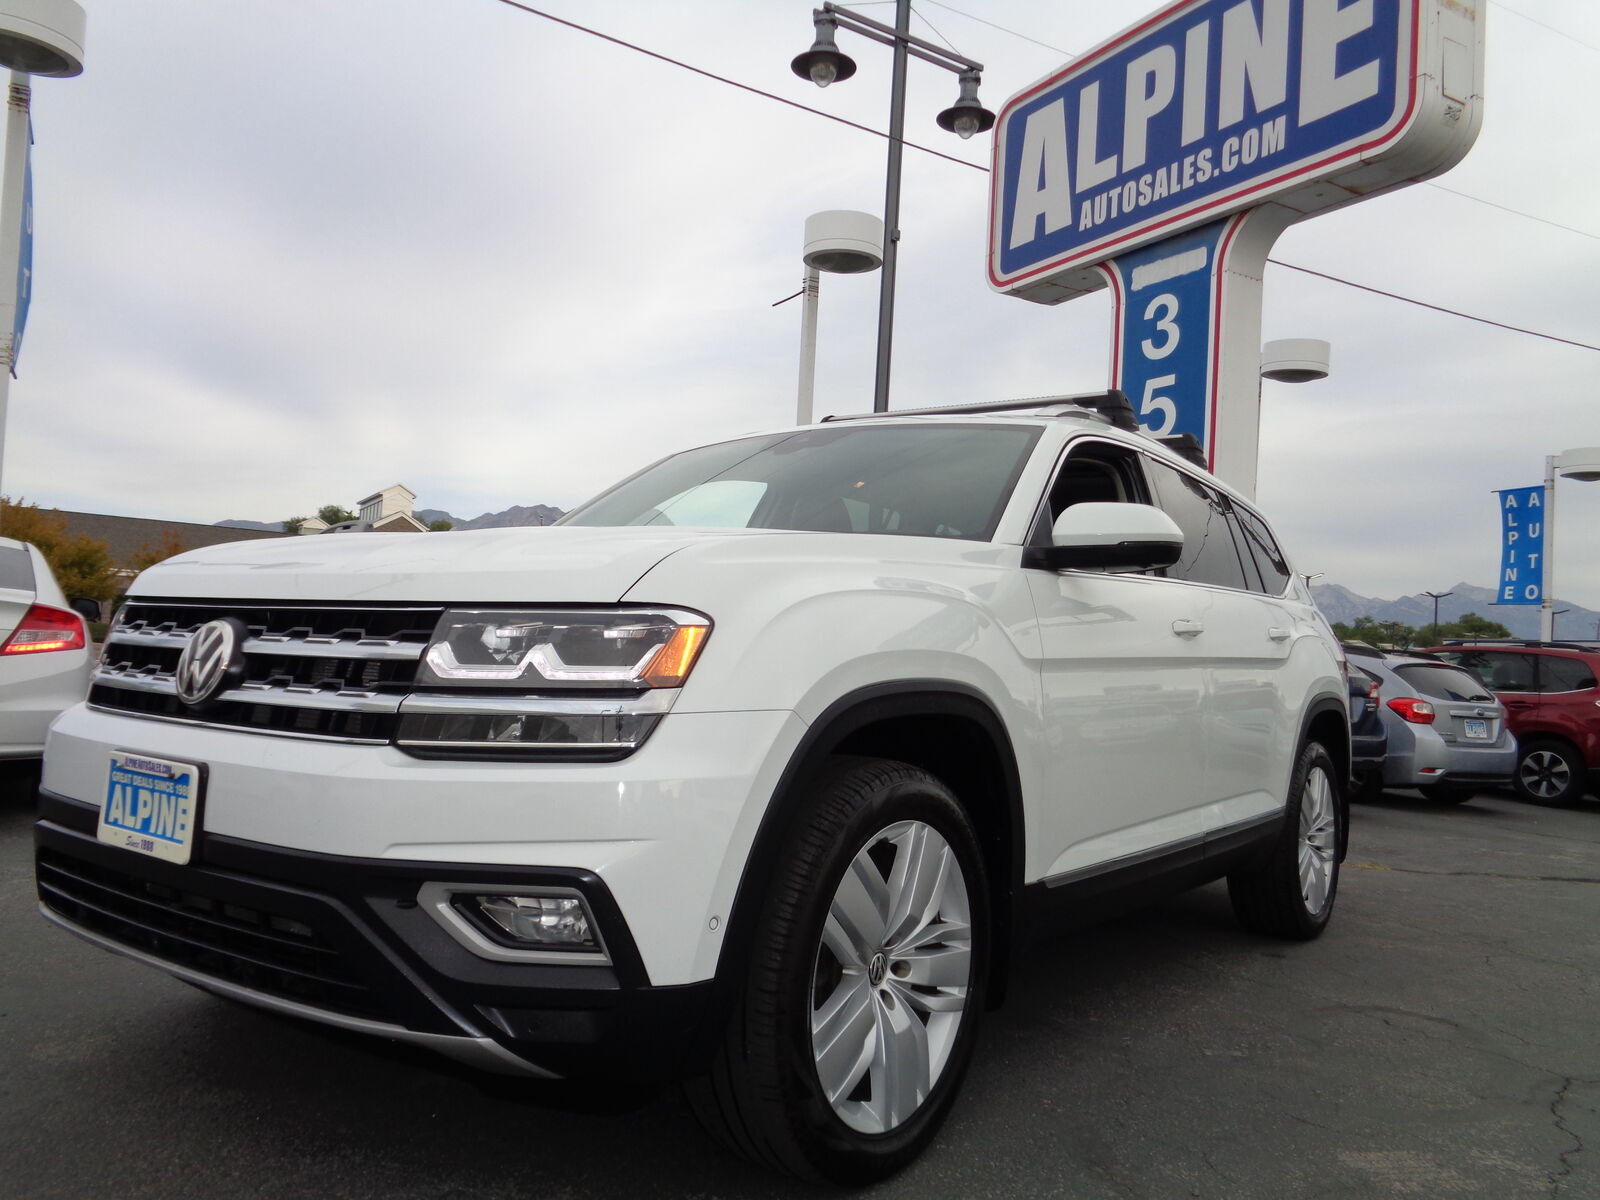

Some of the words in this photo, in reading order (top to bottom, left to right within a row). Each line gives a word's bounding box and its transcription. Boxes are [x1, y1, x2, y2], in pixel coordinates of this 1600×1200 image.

[1010, 0, 1380, 249] ALPINE
[1079, 115, 1286, 231] AUTOSALES.COM
[1504, 494, 1519, 600] ALPINE
[1525, 492, 1540, 600] AUTO
[108, 784, 188, 840] ALPINE
[112, 771, 133, 784] GREAT
[133, 775, 153, 789] DEALS
[155, 779, 175, 793] SINCE
